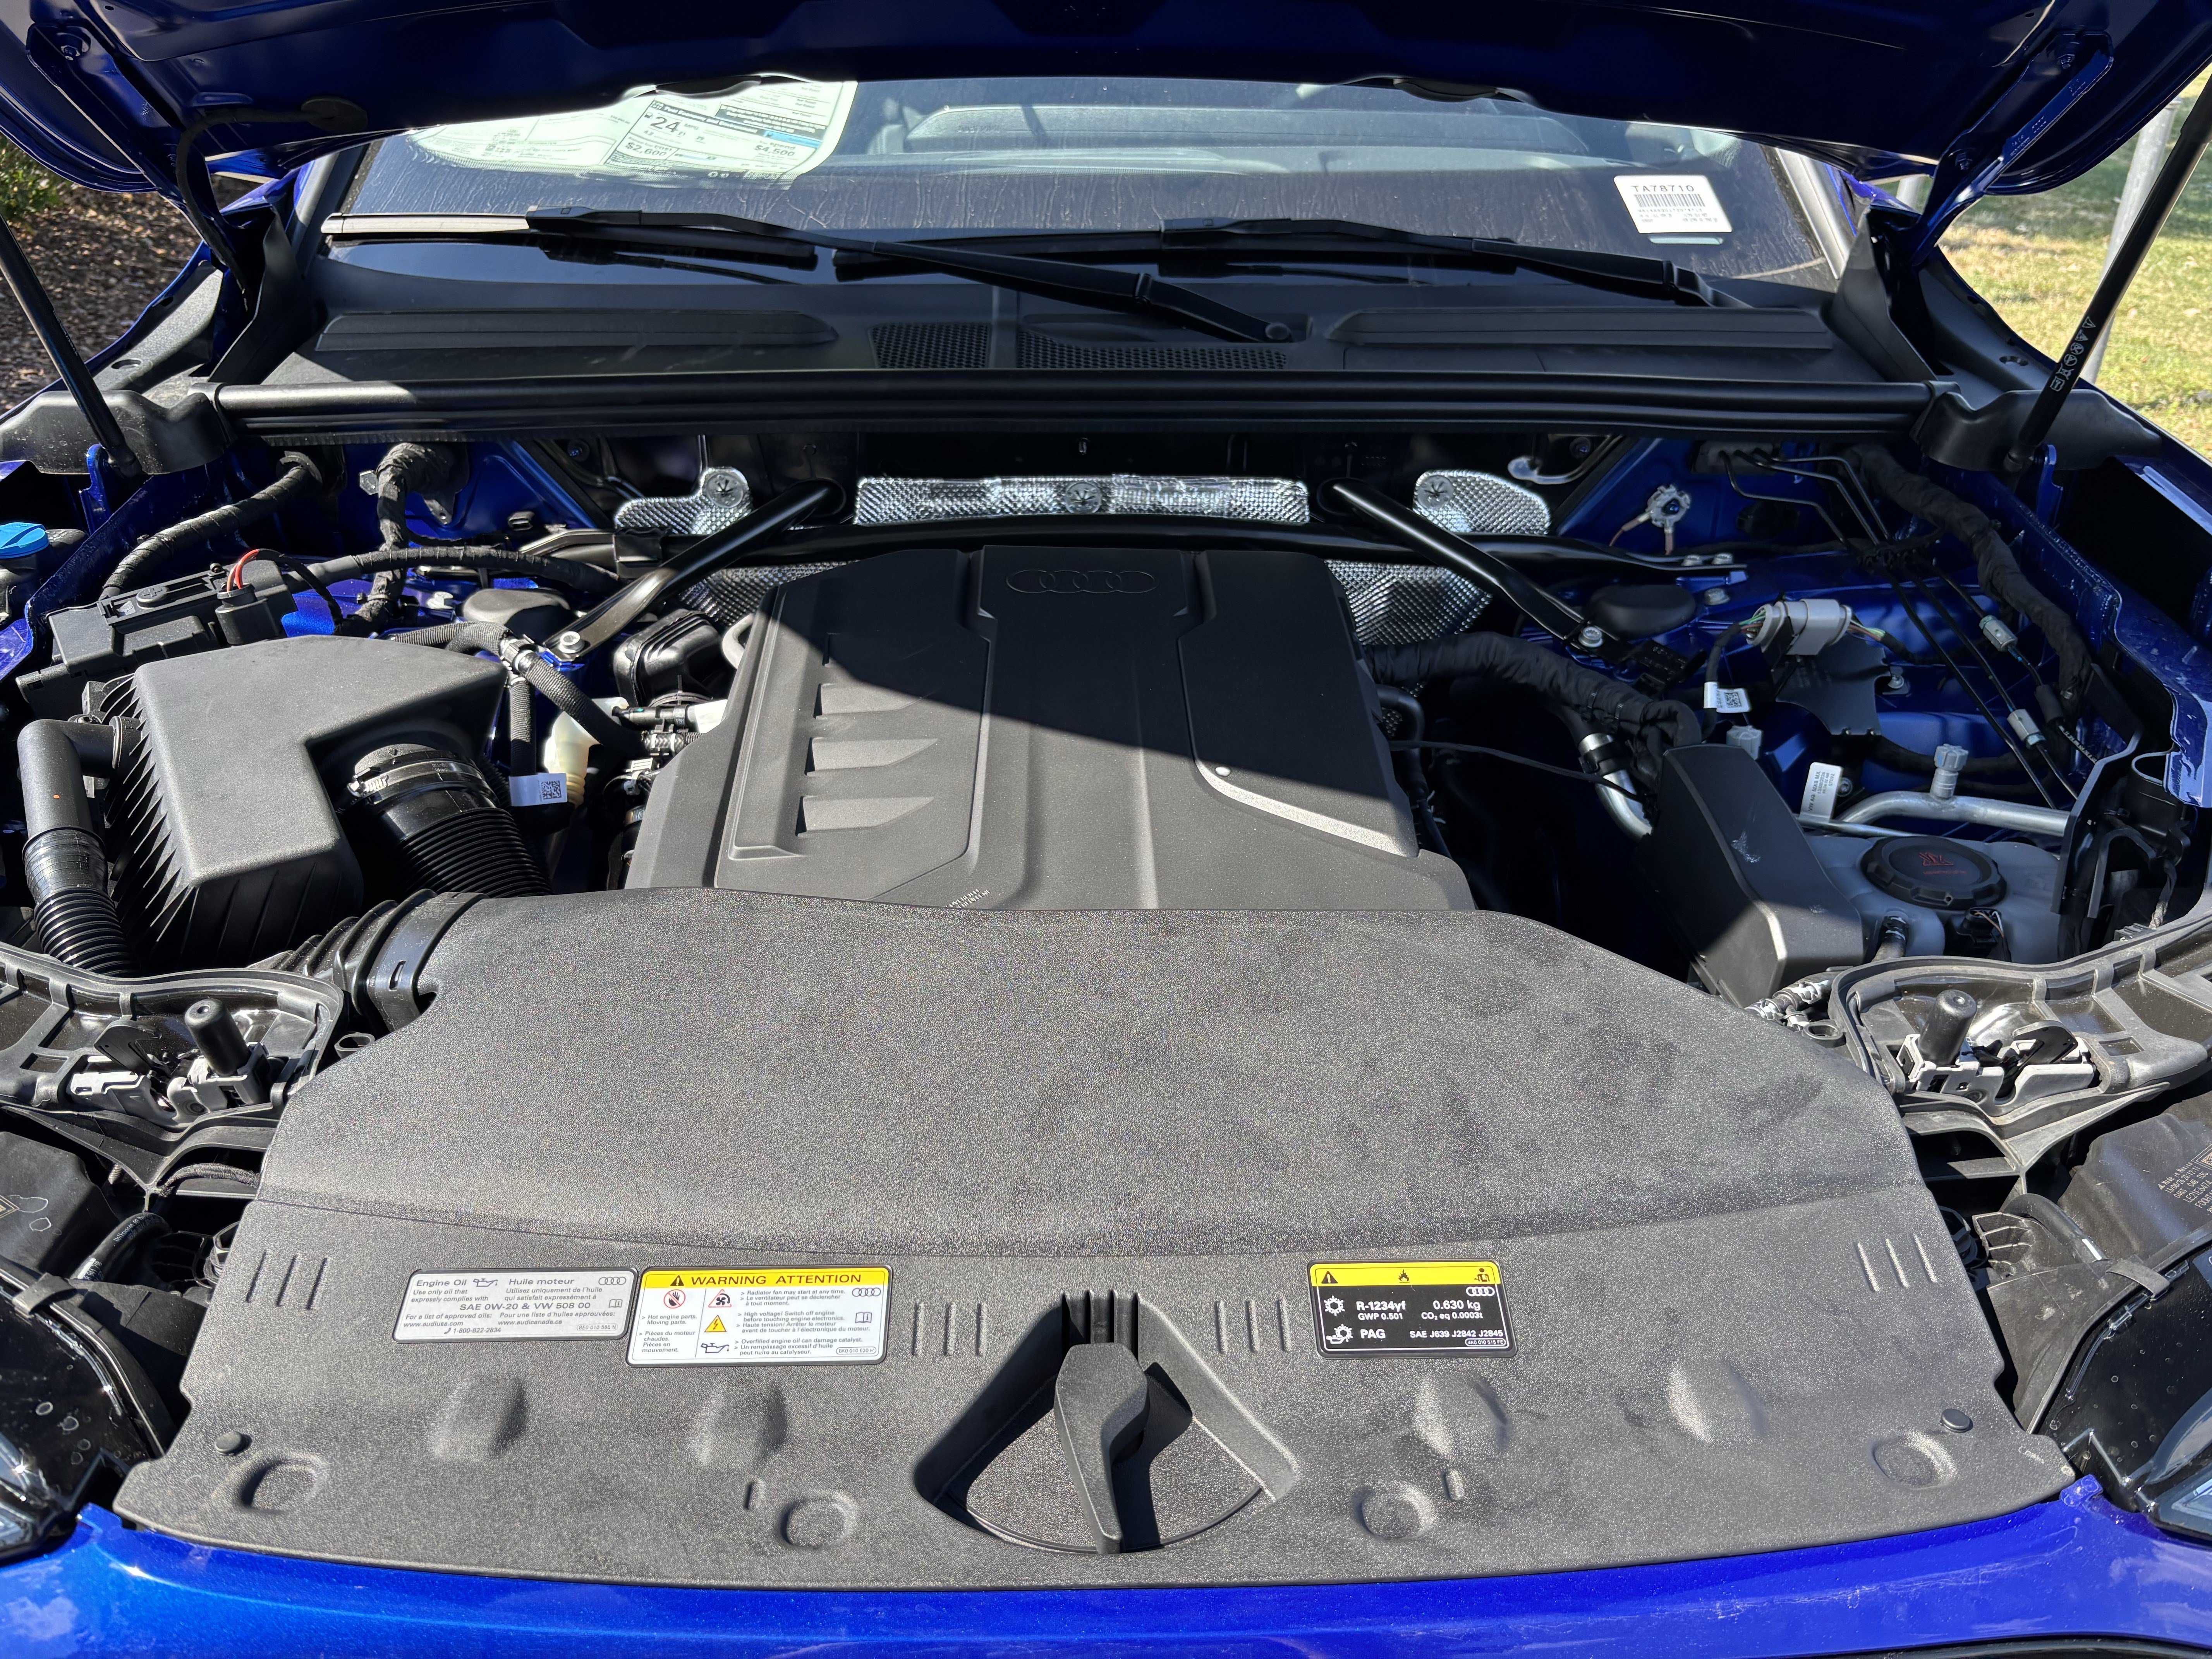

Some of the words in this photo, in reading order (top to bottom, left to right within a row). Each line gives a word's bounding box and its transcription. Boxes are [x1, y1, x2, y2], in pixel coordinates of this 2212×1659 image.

[650, 117, 681, 133] 24
[625, 142, 667, 156] $2,600
[754, 145, 795, 156] $4,500
[691, 1276, 766, 1285] WARNING
[775, 1274, 862, 1284] ATTENTION
[1356, 1300, 1406, 1312] R-1234yf
[1433, 1300, 1464, 1310] 0.630
[1467, 1300, 1481, 1311] kg
[1358, 1312, 1379, 1321] GWP
[1360, 1329, 1386, 1339] PAG
